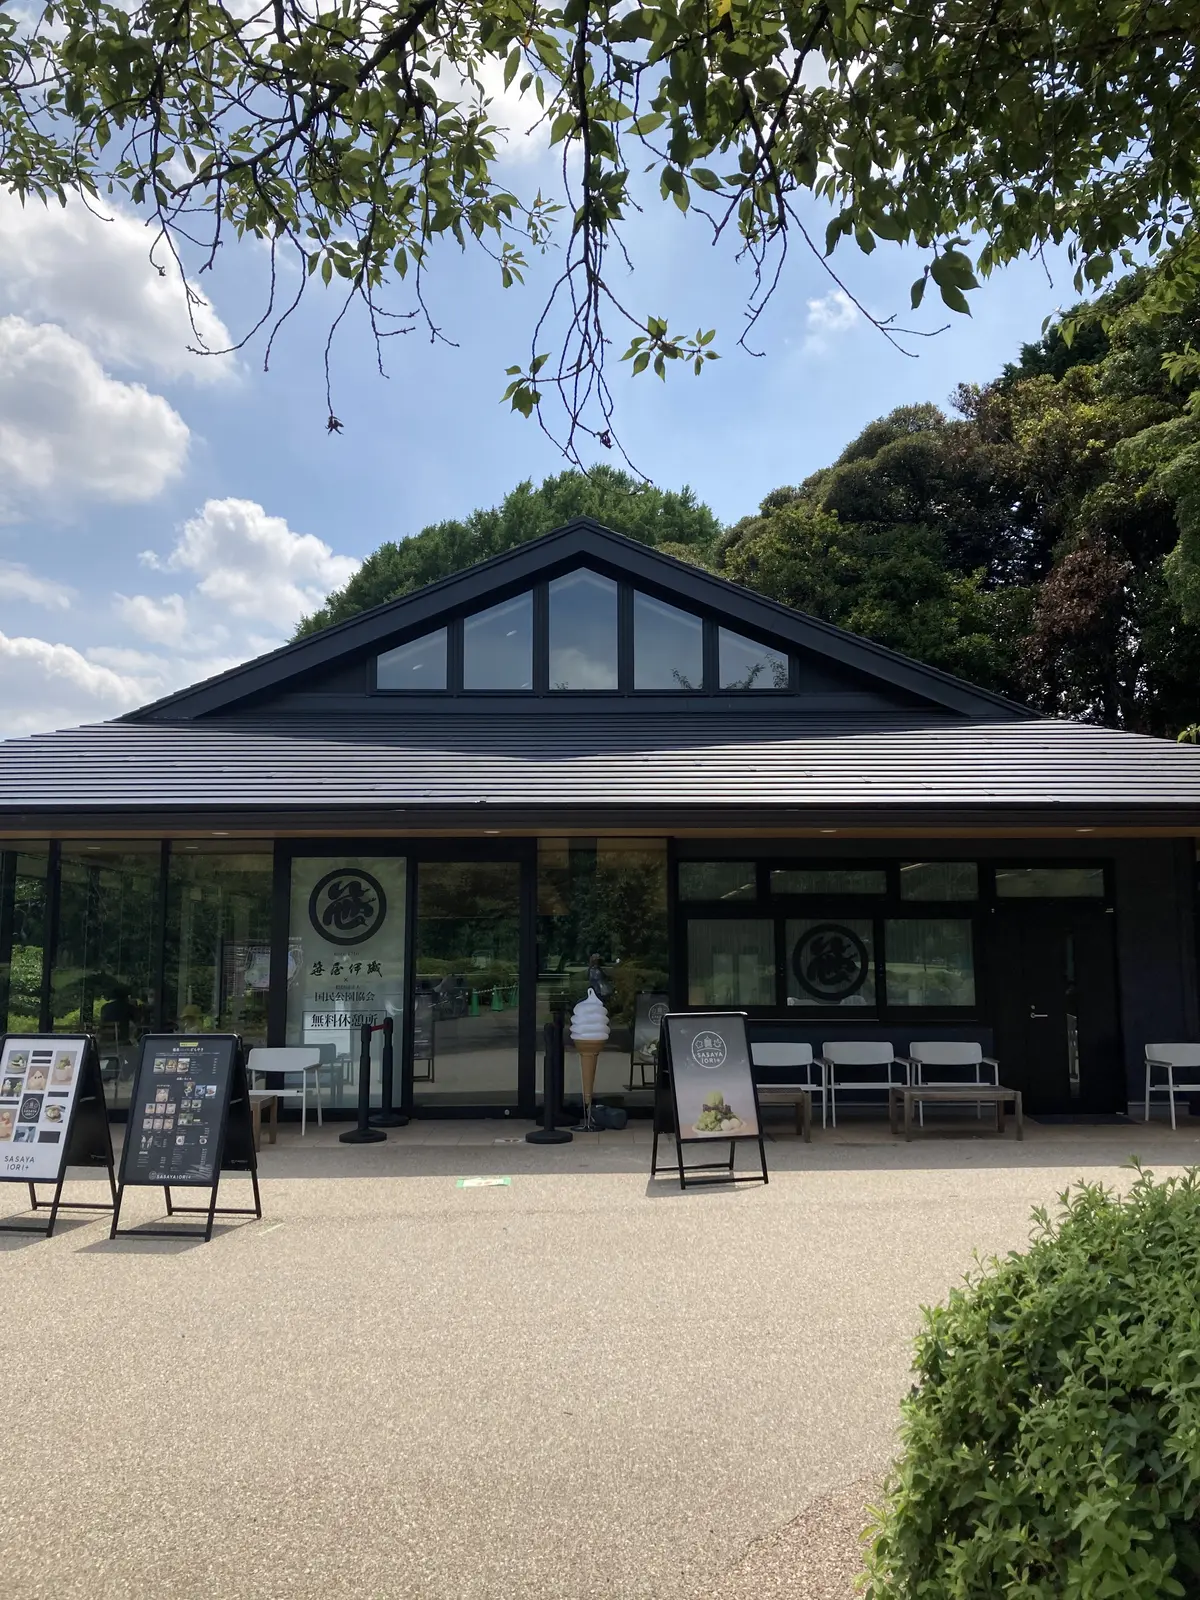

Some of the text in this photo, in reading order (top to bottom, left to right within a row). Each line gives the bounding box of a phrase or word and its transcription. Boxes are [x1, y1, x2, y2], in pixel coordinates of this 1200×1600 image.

[314, 991, 376, 1002] 国民公園協会
[310, 1013, 378, 1027] 無料休憩所
[4, 1155, 35, 1163] SASAYA
